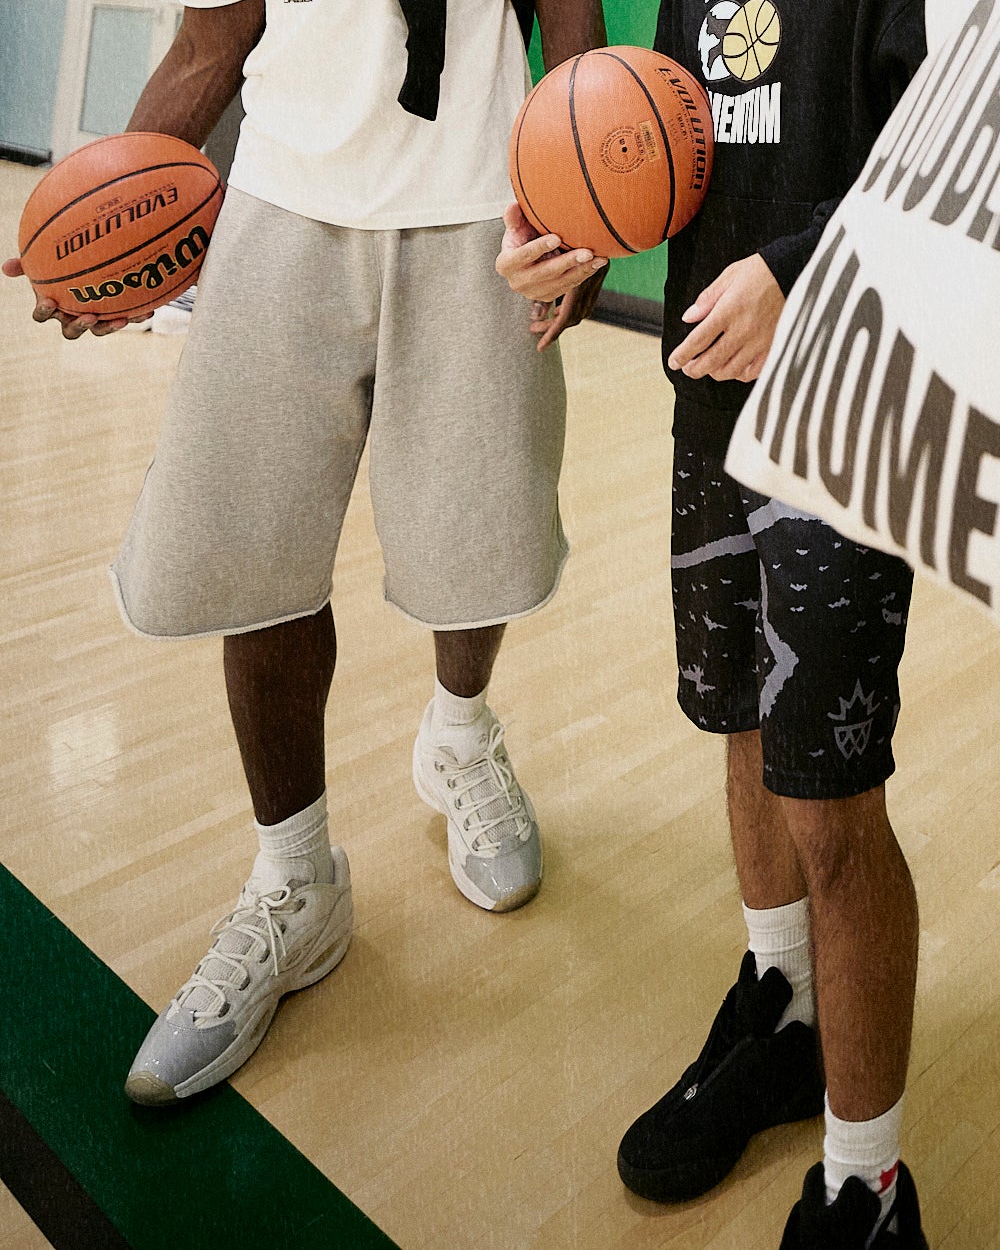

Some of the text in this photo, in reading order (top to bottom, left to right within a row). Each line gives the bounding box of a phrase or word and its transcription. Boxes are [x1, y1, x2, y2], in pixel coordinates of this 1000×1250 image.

[658, 67, 708, 191] EVOLUTION
[706, 82, 782, 145] MENTUM
[55, 186, 179, 262] EVOLUTION
[68, 224, 211, 304] Wilson
